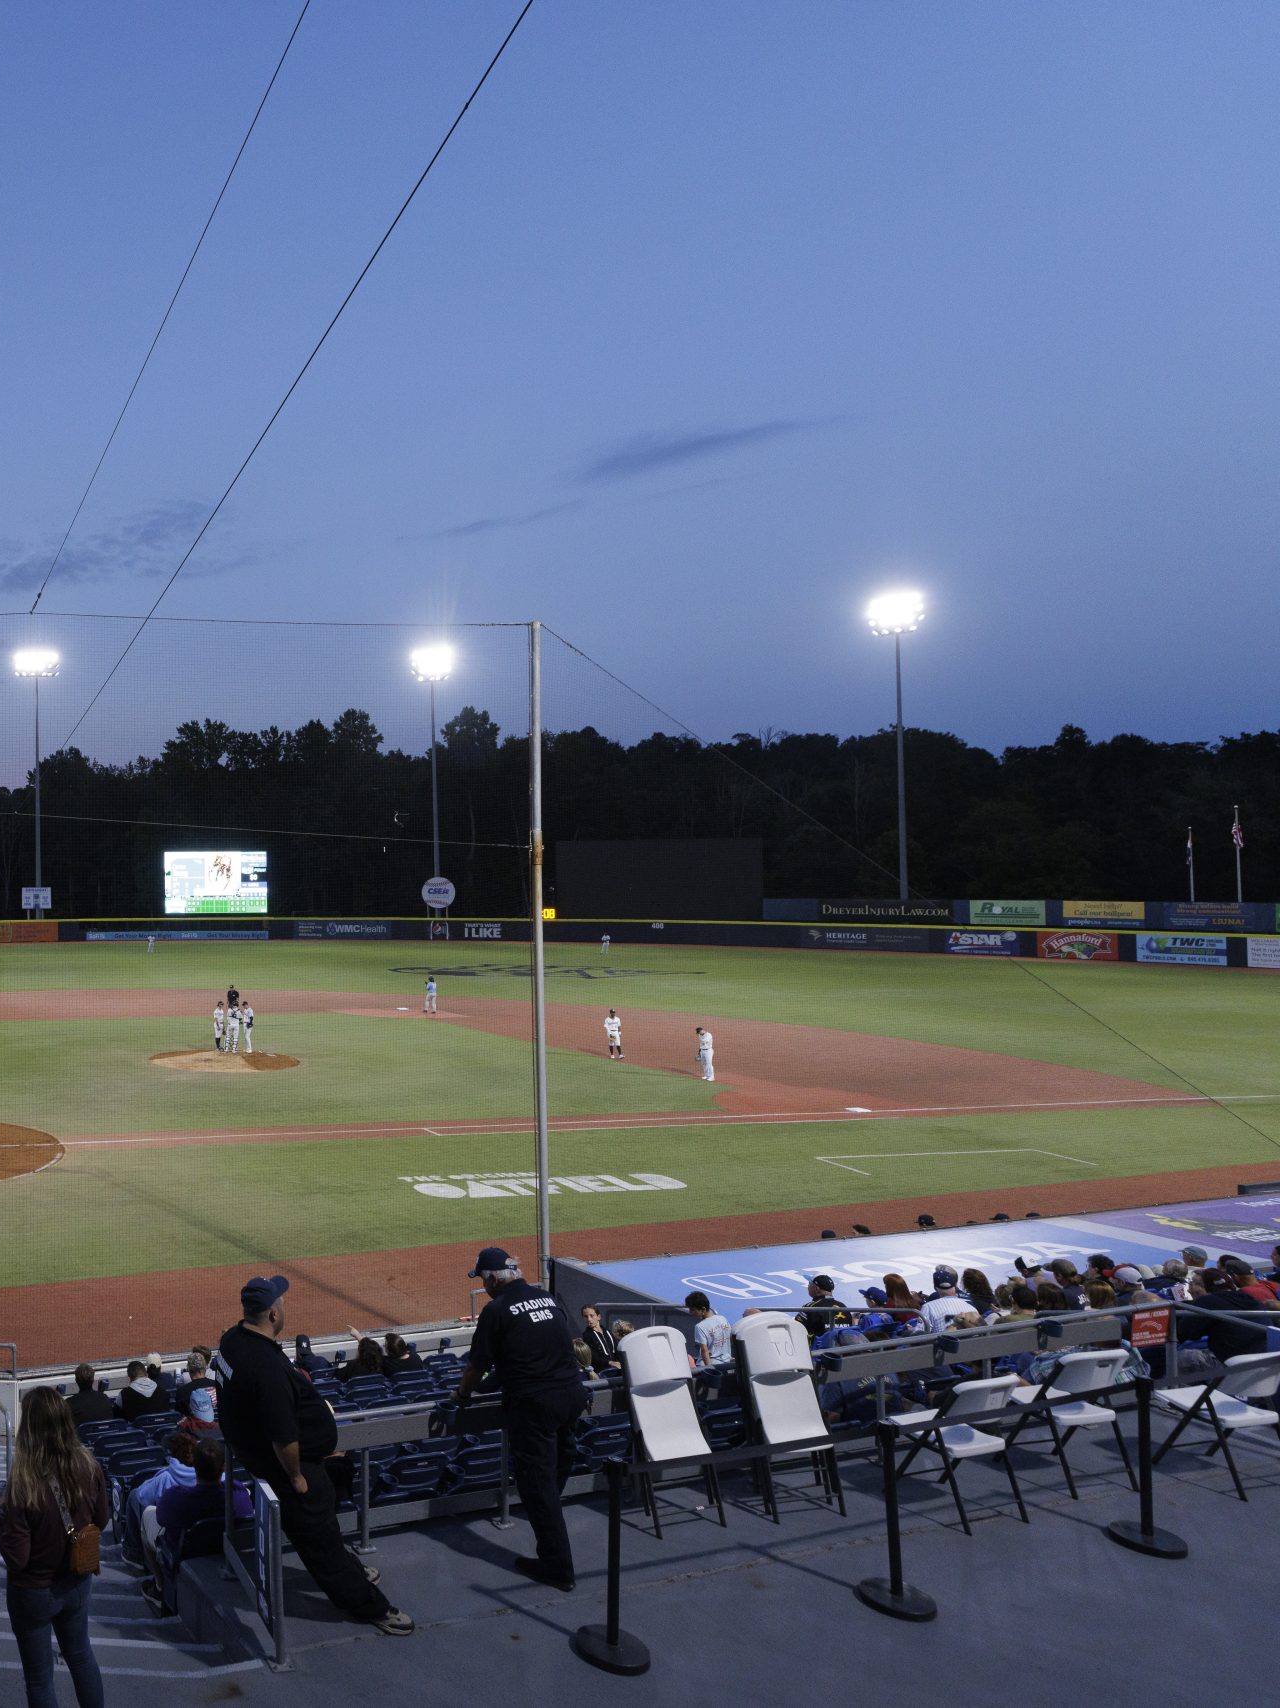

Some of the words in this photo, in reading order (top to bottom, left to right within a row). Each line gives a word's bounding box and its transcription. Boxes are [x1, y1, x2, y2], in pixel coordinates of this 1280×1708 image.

[335, 924, 386, 933] WMCHealth
[464, 928, 470, 938] I
[471, 928, 502, 938] LIKE
[1050, 933, 1103, 950] Hannaford
[1171, 938, 1204, 946] TWC
[768, 1241, 1112, 1284] HONDA
[510, 1298, 556, 1315] STADIUM
[529, 1310, 554, 1323] EMS
